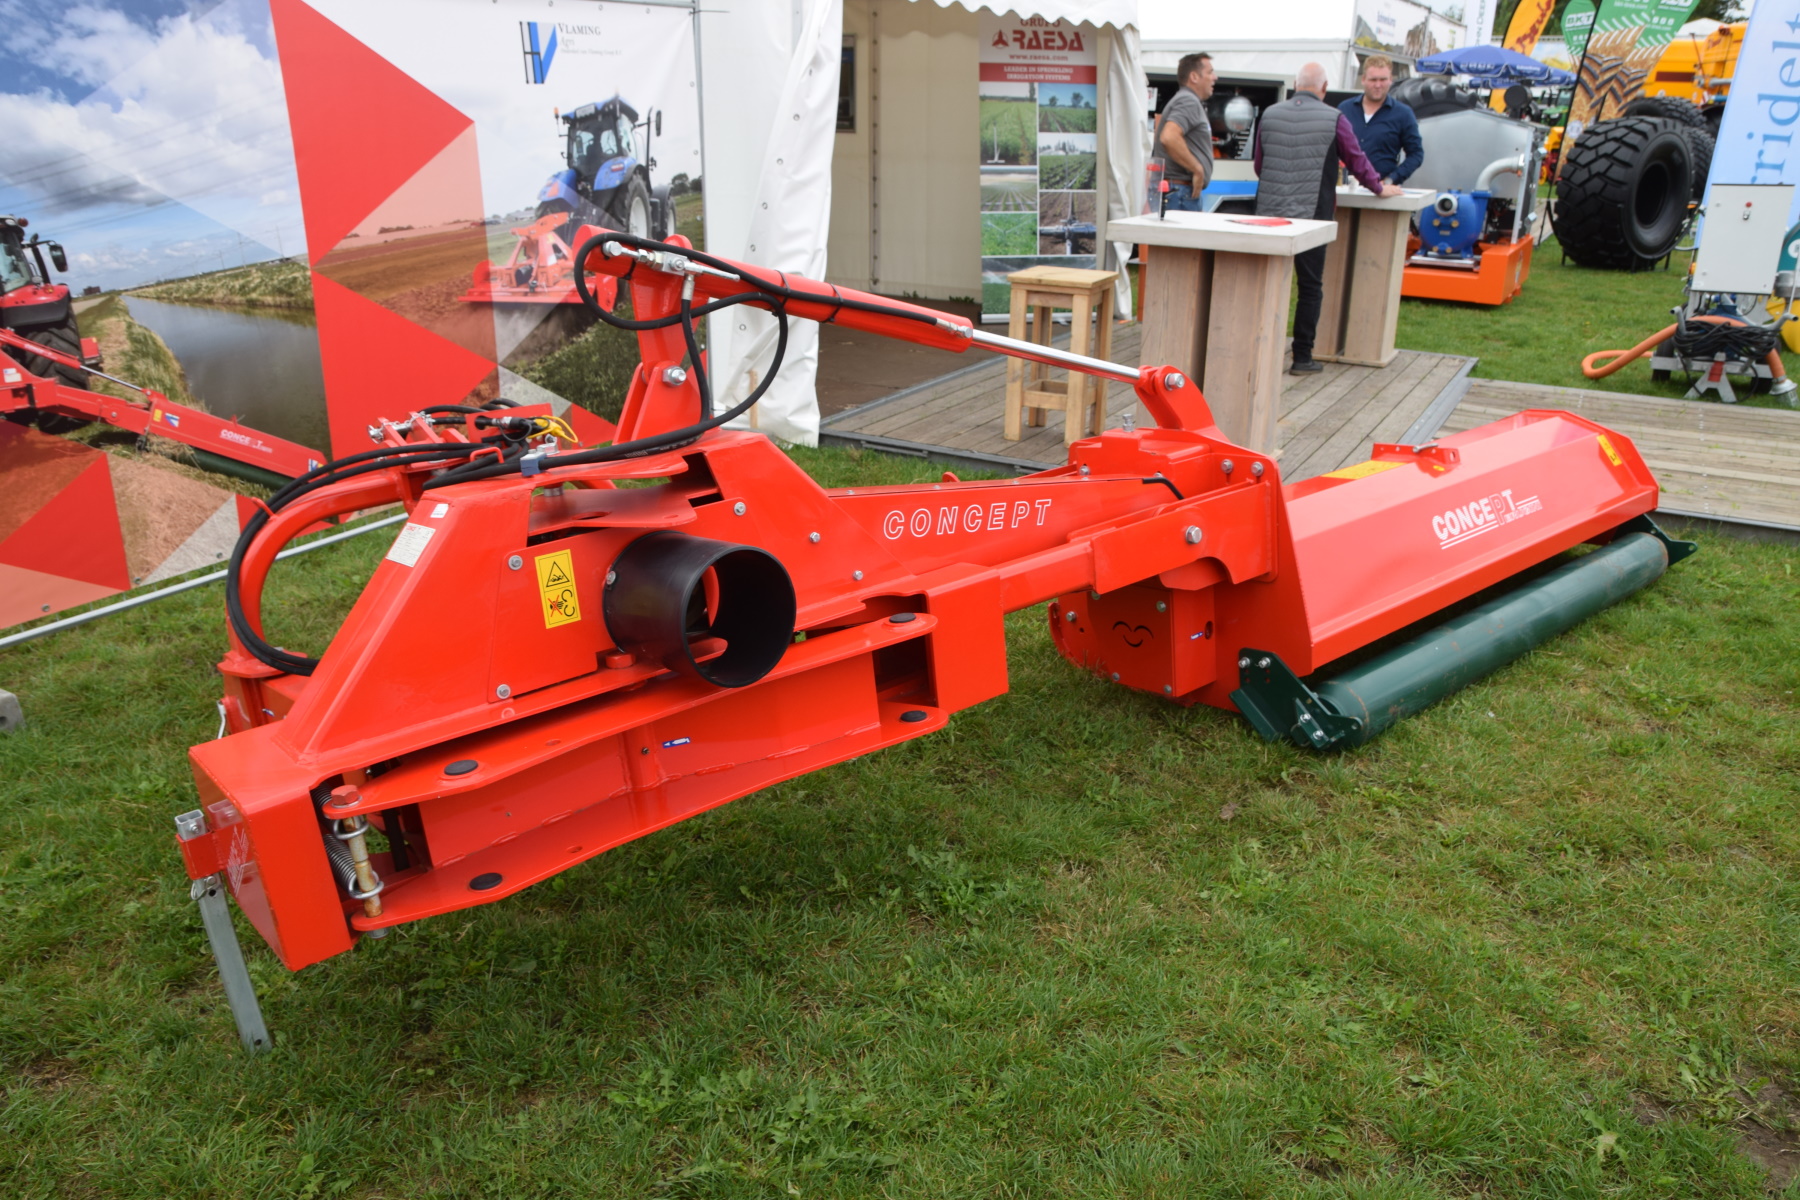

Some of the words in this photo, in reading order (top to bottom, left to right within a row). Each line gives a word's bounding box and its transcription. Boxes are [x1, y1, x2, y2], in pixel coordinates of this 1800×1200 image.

[1566, 12, 1594, 26] BKT
[557, 22, 601, 36] VLAMING
[1012, 29, 1084, 51] RAESA
[1003, 65, 1028, 73] LEADER
[883, 499, 1052, 540] CONCEPT
[1431, 488, 1517, 541] CONCEPT
